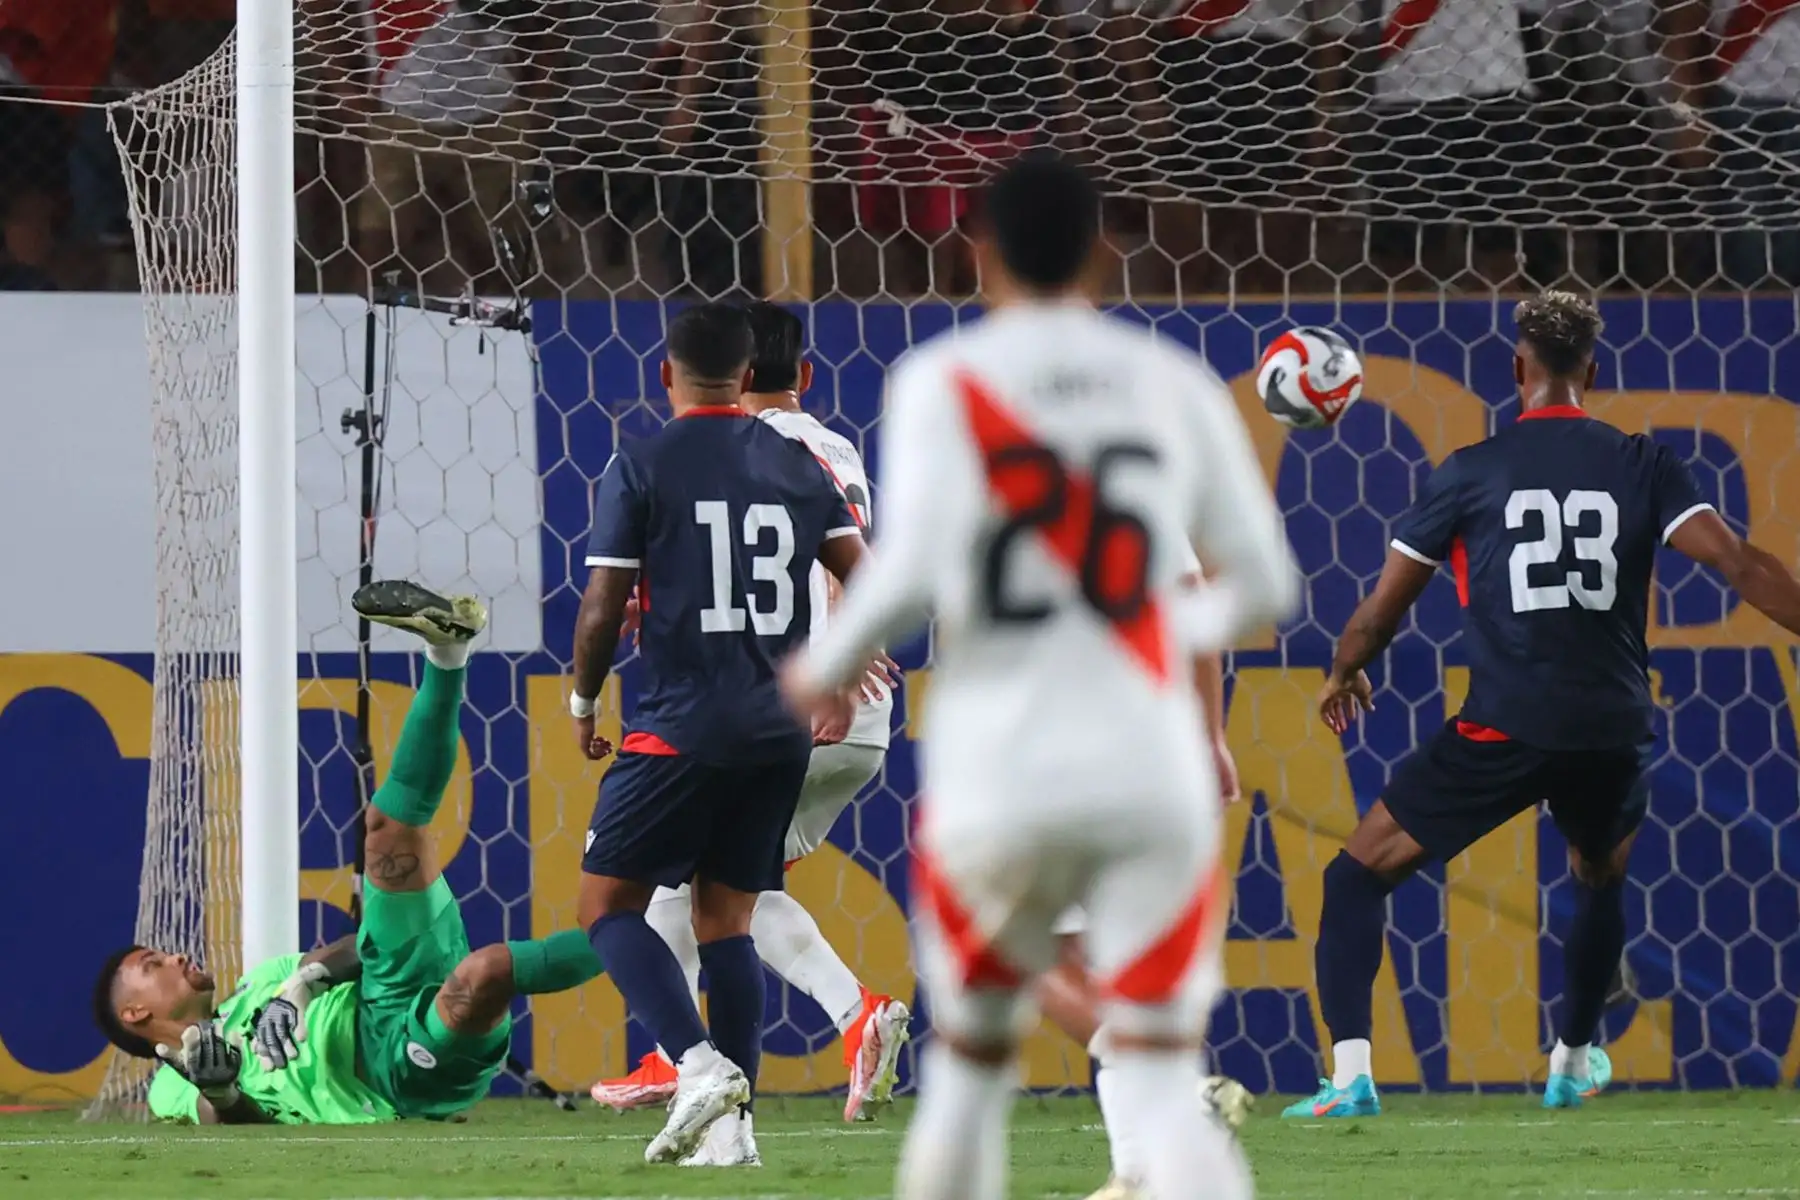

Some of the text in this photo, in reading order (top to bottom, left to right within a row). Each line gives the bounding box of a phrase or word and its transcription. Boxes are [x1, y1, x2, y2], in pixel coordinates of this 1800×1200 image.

[695, 500, 795, 636] 13
[982, 438, 1158, 624] 26
[1504, 488, 1619, 613] 23
[0, 652, 1673, 1096] CRIAL
